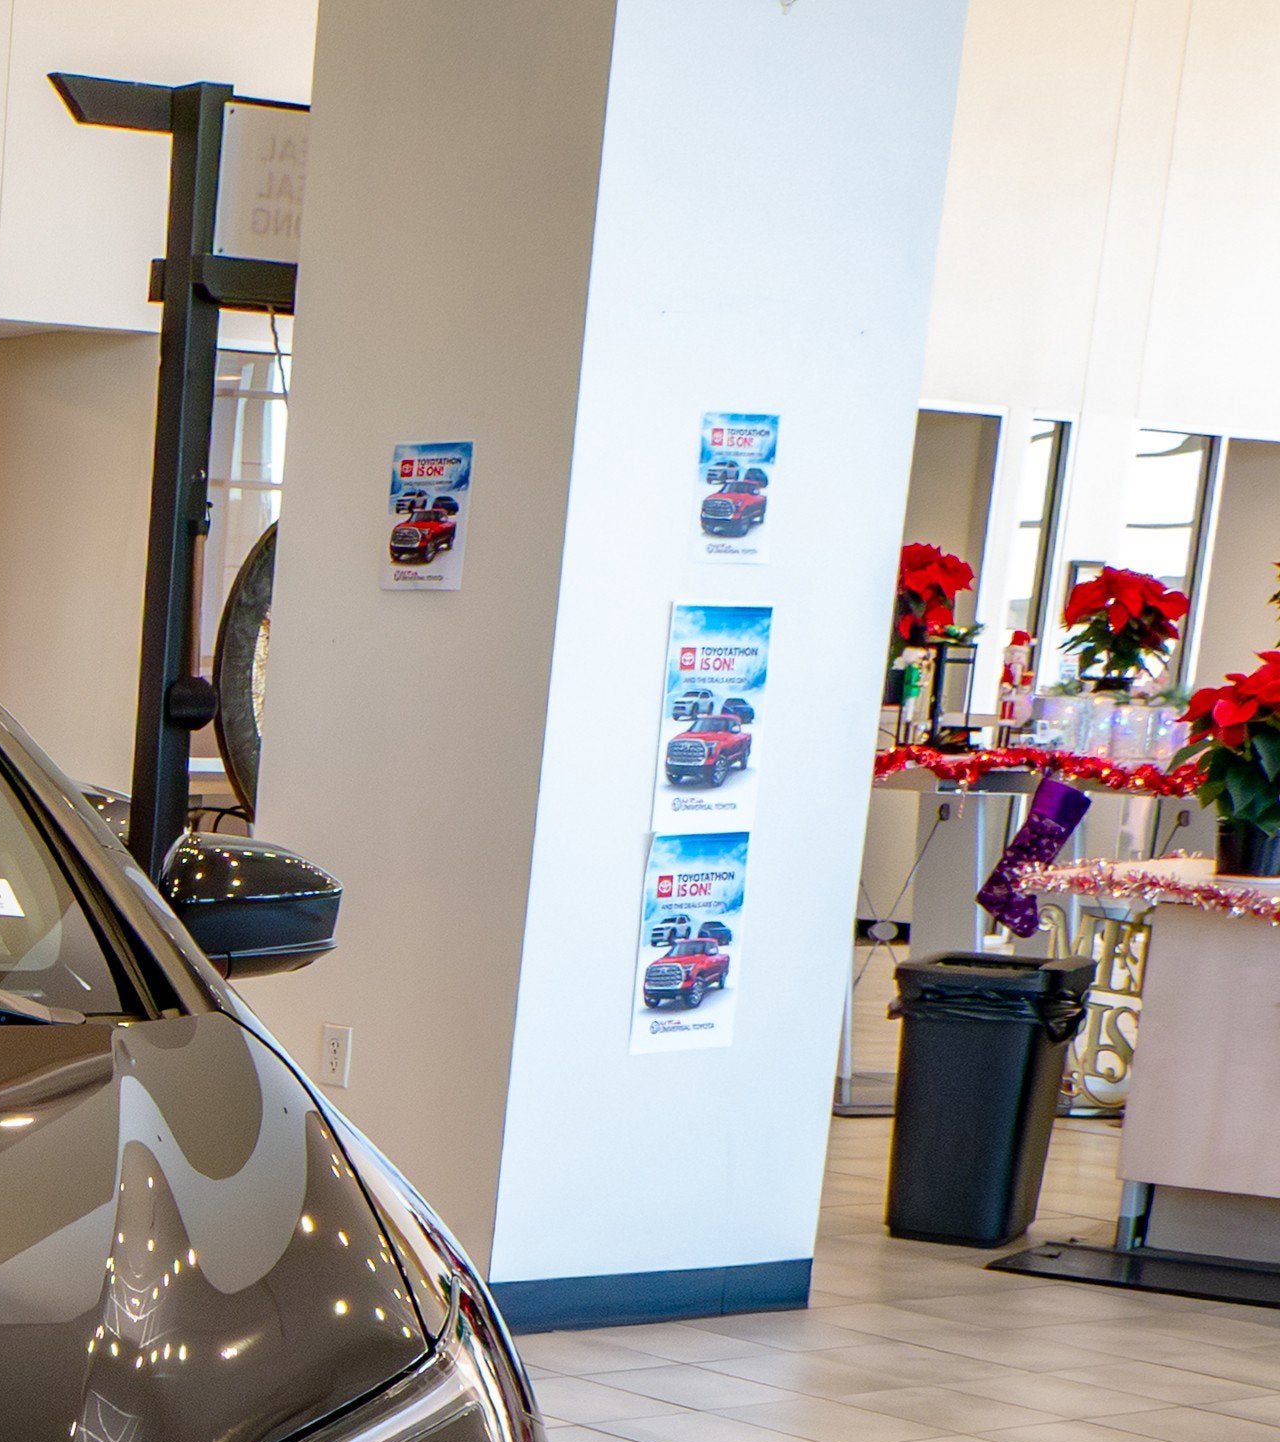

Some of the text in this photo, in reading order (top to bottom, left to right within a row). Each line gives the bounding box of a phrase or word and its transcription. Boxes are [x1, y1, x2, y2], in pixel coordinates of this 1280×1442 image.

[701, 647, 759, 657] TOYOTATHON
[701, 658, 735, 671] IS ON!
[677, 871, 736, 882] TOYOTATHON
[677, 883, 712, 897] IS ON!
